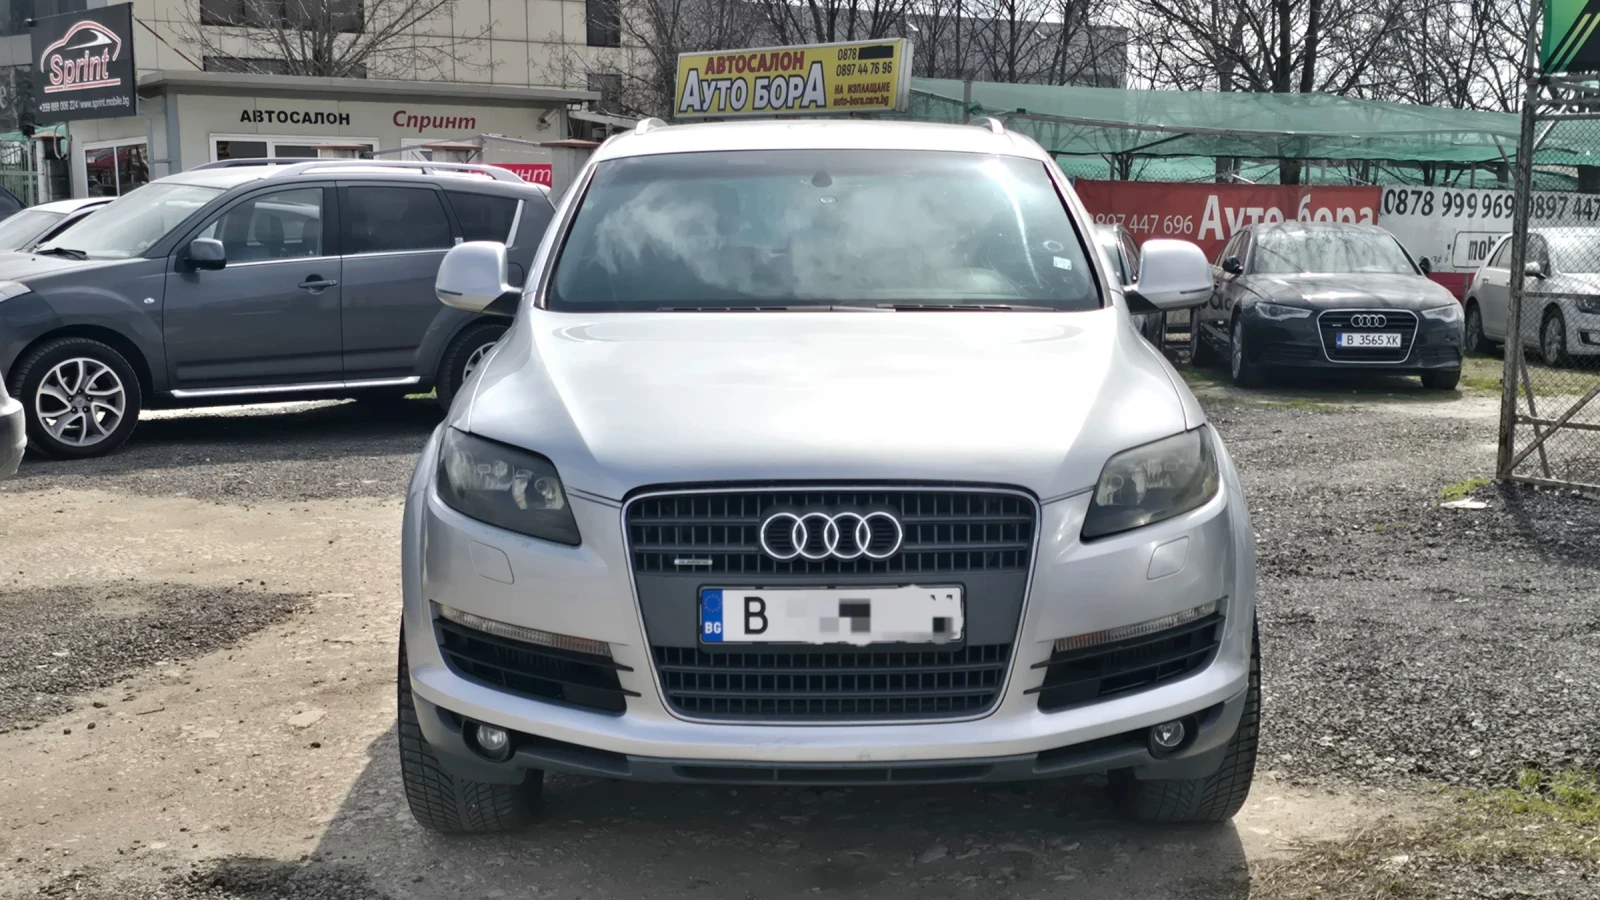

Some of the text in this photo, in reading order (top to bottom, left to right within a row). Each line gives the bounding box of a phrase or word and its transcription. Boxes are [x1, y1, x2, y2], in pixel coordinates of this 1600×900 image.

[705, 51, 805, 75] АВТОСАЛОН
[837, 48, 857, 61] 0878
[49, 47, 109, 91] Sprint
[836, 61, 893, 77] 0897 44 76 96
[834, 82, 890, 95] НА ИЗПЛАЩАНЕ
[80, 96, 130, 110] www.sprint.mobile.bg
[240, 109, 476, 133] АВТОСАЛОН Спринт
[1384, 189, 1434, 216] 0878
[1442, 191, 1478, 218] 999
[1481, 193, 1515, 219] 969
[1089, 213, 1193, 234] 897 447 696
[1468, 236, 1502, 260] mob
[1347, 335, 1399, 346] B 3565 XK
[744, 596, 769, 635] B
[704, 621, 722, 635] BG
